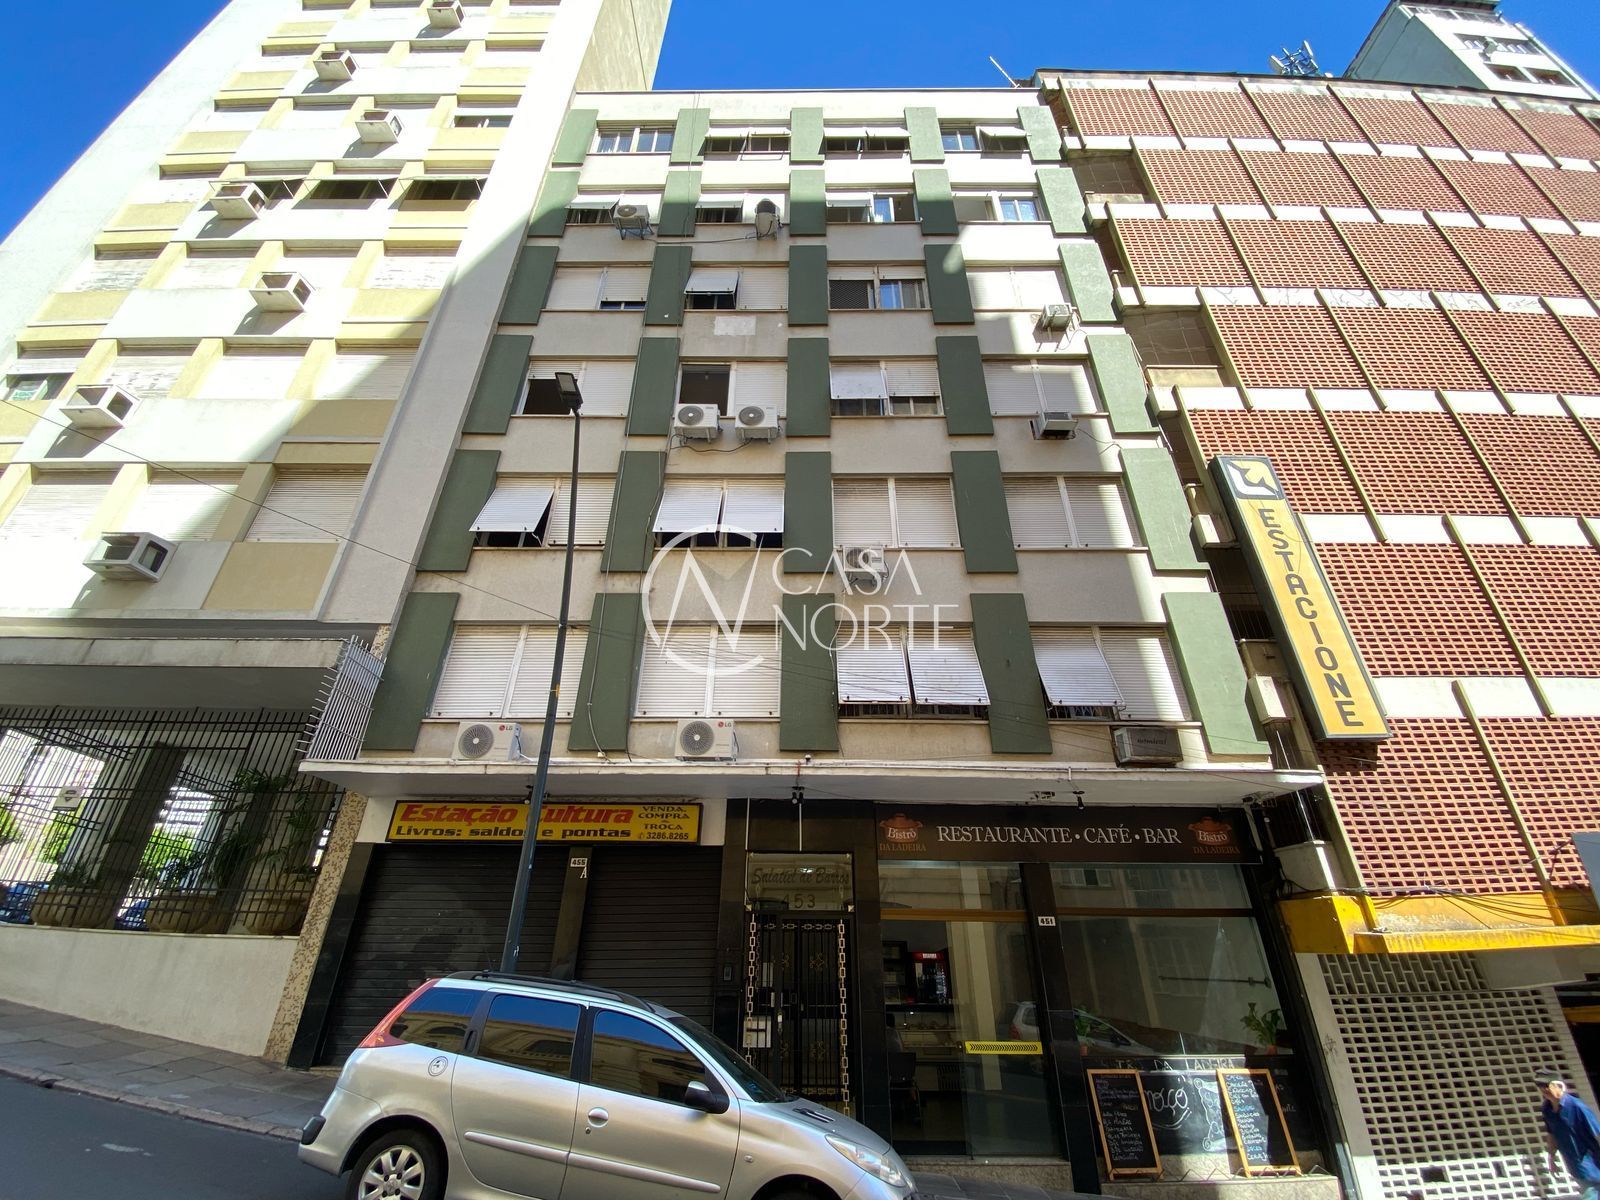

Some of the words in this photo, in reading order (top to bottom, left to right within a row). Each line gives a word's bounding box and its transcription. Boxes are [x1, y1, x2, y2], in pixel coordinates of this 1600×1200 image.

[1257, 508, 1364, 727] ESTACIONE
[400, 803, 518, 826] Estação
[527, 804, 633, 824] ultura
[396, 826, 462, 836] Livros:
[469, 826, 528, 837] saldo
[542, 829, 553, 837] e
[562, 827, 631, 839] pontas
[936, 826, 1073, 843] RESTAURANTE
[1083, 823, 1132, 844] CAFÉ
[1143, 827, 1182, 844] BAR
[579, 866, 587, 879] A
[1040, 917, 1054, 925] 451
